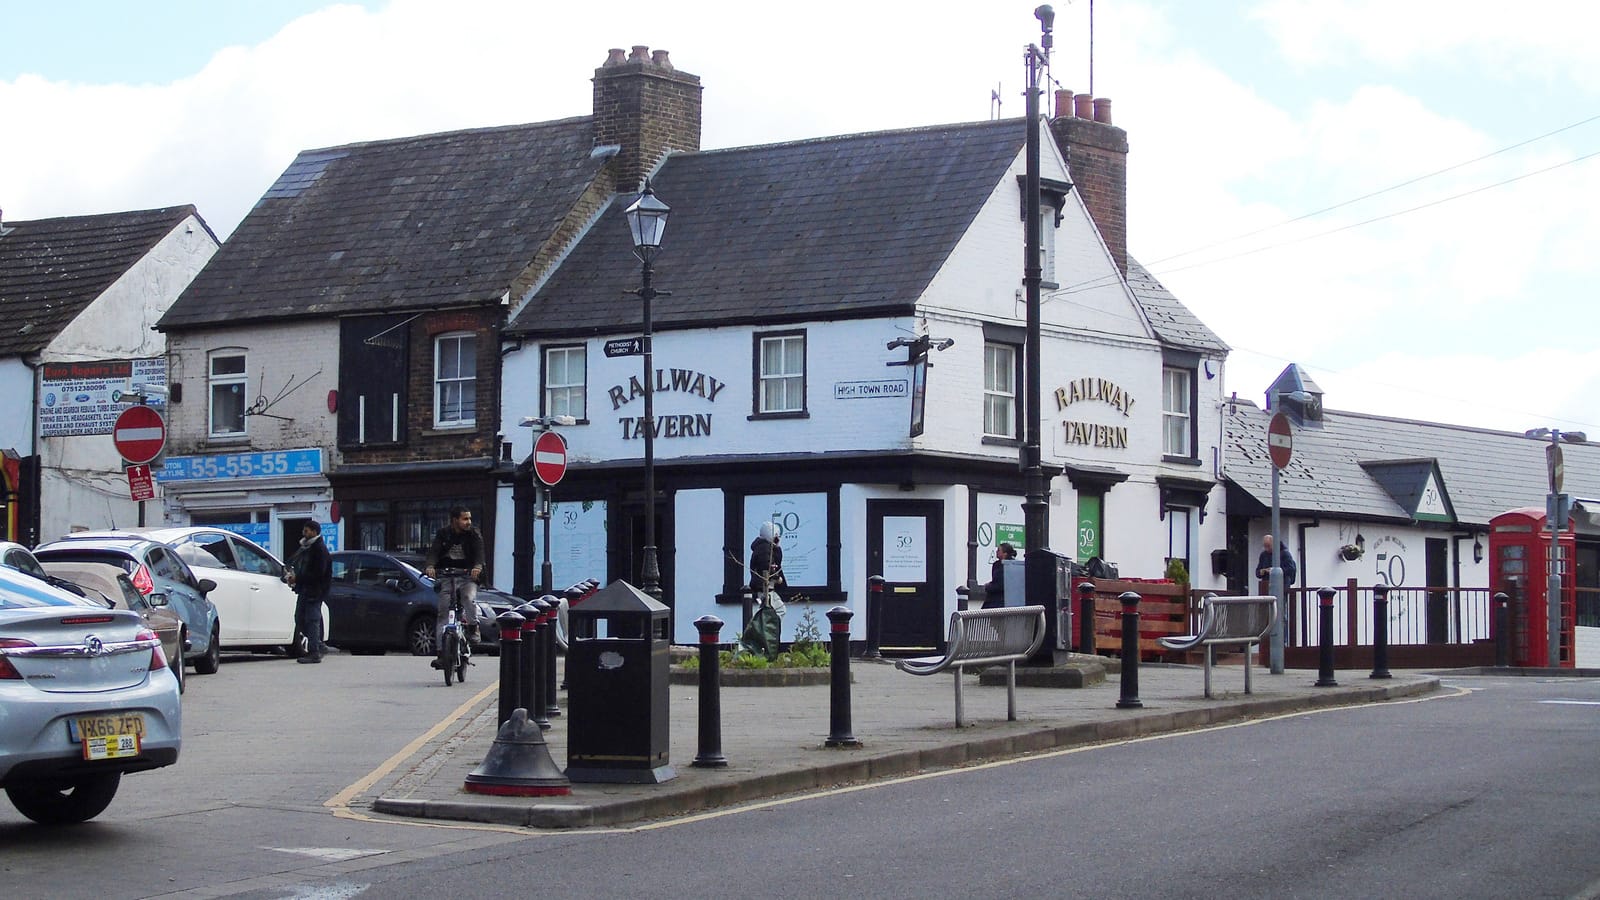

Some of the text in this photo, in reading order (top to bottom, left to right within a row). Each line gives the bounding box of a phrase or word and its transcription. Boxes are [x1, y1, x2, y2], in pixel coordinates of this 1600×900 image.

[608, 341, 632, 349] METHODIST
[71, 364, 110, 377] Repairs
[607, 368, 726, 411] RALWAY
[838, 383, 904, 394] HIGH TOWN ROAD
[1054, 377, 1135, 418] RAILWAY
[618, 413, 713, 440] TAVERN
[1062, 420, 1129, 449] TAVERN
[192, 453, 288, 478] 55-55-55
[563, 510, 578, 526] 50
[771, 511, 800, 538] 50
[896, 535, 913, 549] 50
[1079, 528, 1095, 548] 50
[79, 717, 143, 737] VX66 ZFD
